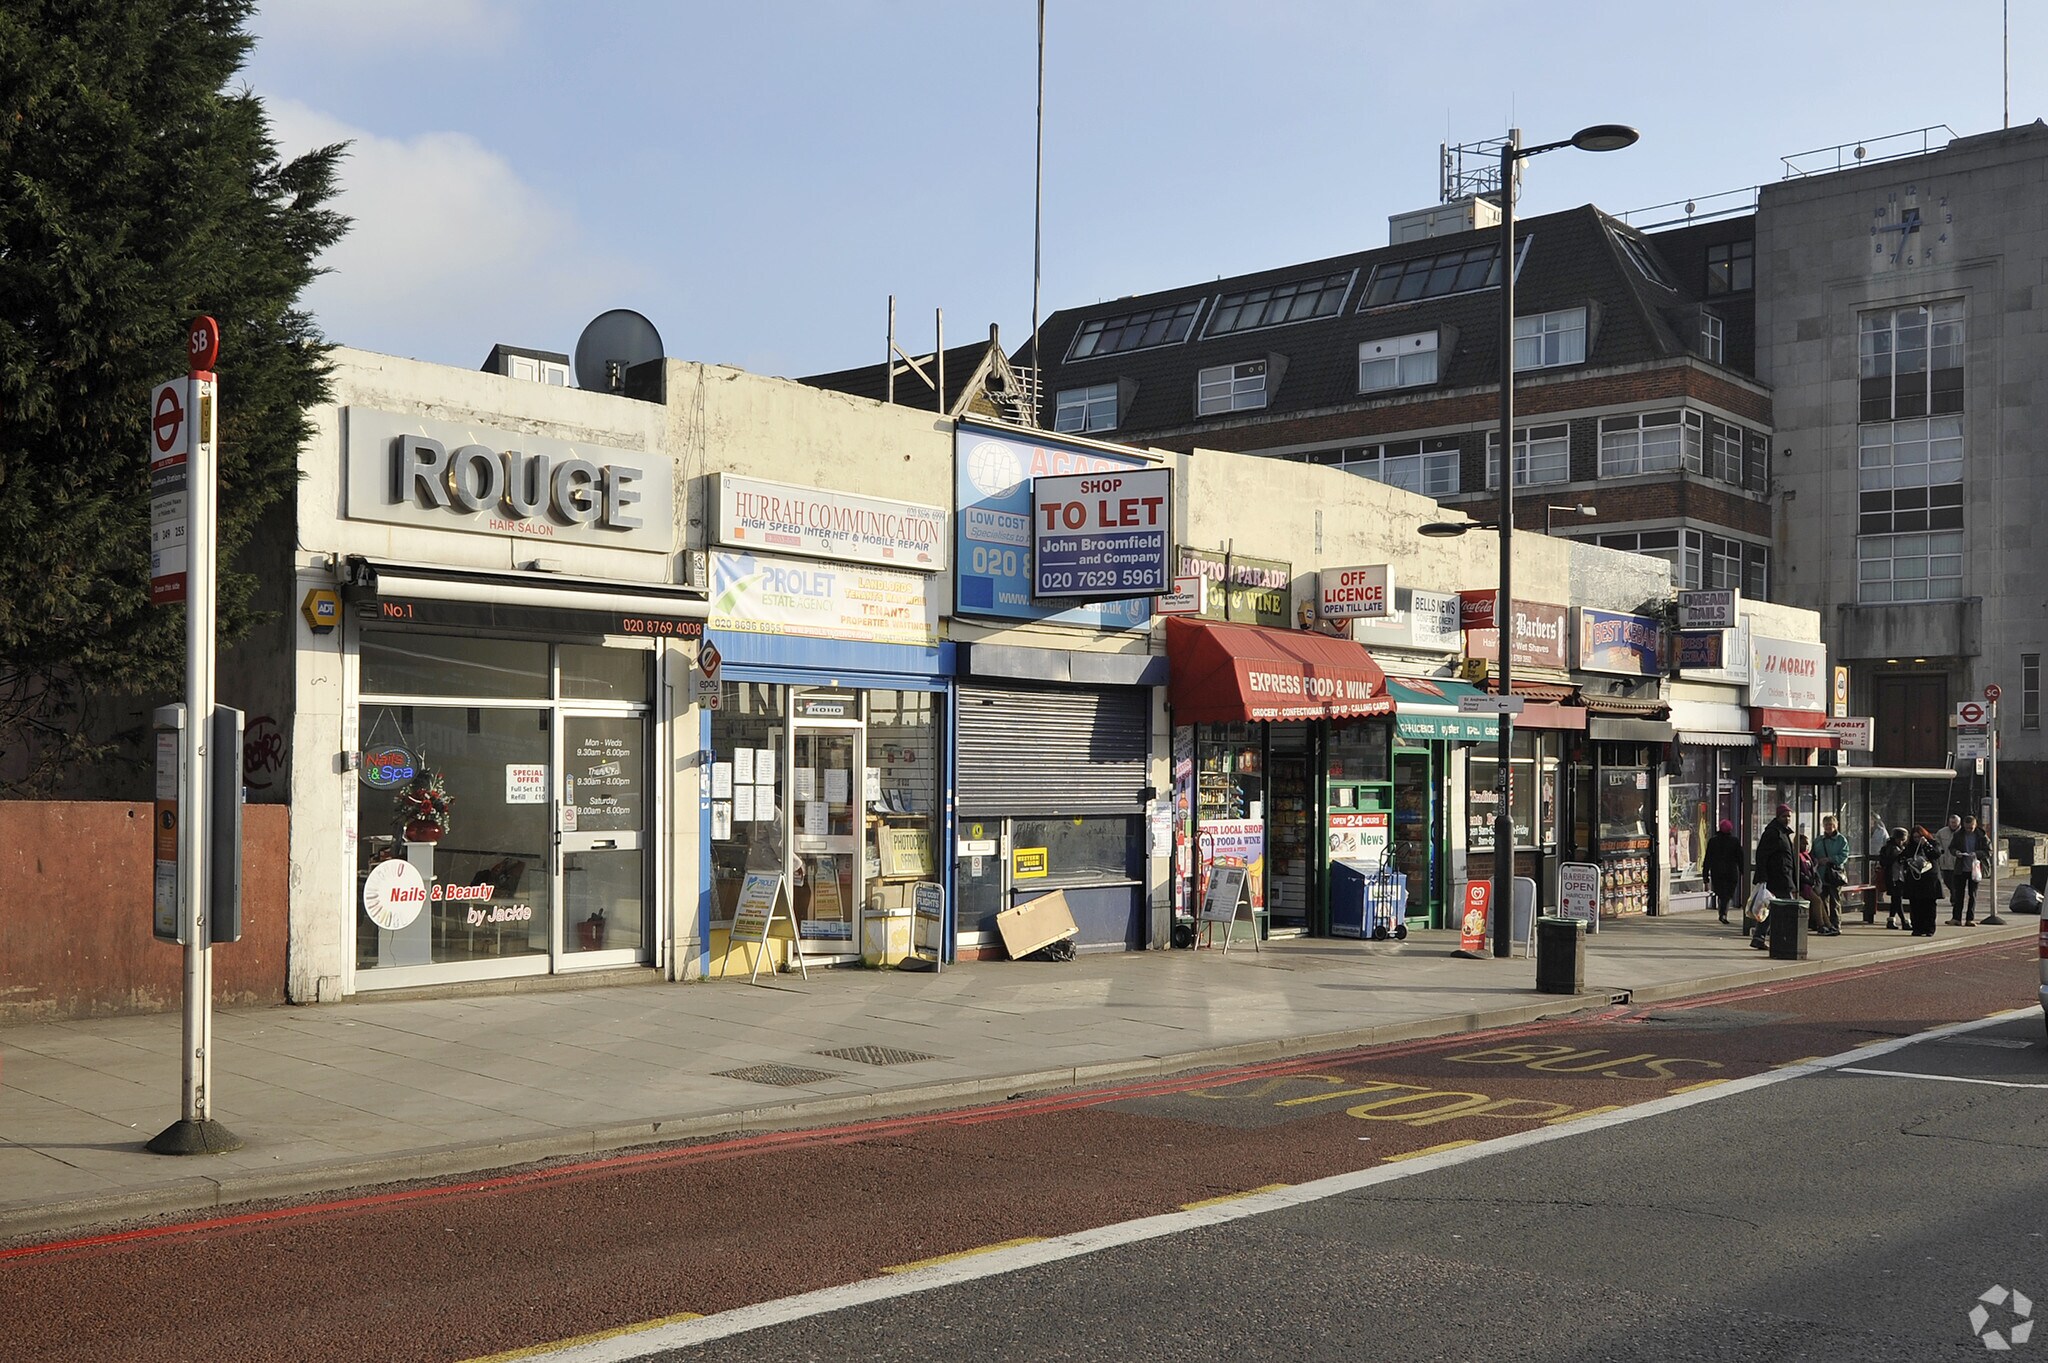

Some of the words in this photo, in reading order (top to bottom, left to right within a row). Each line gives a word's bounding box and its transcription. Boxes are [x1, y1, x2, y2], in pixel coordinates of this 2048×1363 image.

[1905, 185, 1917, 196] 12
[1888, 192, 1896, 203] 11
[1940, 197, 1947, 207] 2
[1875, 207, 1886, 218] 10
[1946, 214, 1952, 224] 3
[1870, 227, 1877, 236] 9
[1938, 233, 1948, 243] 4
[1875, 244, 1882, 253] 8
[1925, 248, 1932, 258] 5
[1890, 254, 1896, 264] 7
[1907, 256, 1913, 265] 6
[192, 330, 208, 353] SB
[391, 434, 643, 533] ROUGE
[1081, 479, 1122, 494] SHOP
[735, 491, 804, 526] HURRAH
[808, 502, 939, 544] COMMUNICATION
[970, 511, 994, 526] LOW
[998, 516, 1025, 530] COST
[1040, 501, 1087, 531] TO
[1098, 497, 1164, 528] LET
[175, 526, 184, 537] 255
[489, 519, 515, 532] HAIR
[518, 522, 553, 537] SALON
[741, 518, 766, 530] HIGH
[768, 522, 800, 535] SPEED
[803, 527, 850, 541] INTERNET
[852, 533, 859, 543] &
[862, 534, 894, 547] MOBILE
[897, 539, 929, 551] REPAIR
[970, 526, 1014, 542] Specialists
[1042, 538, 1077, 554] John
[1081, 535, 1161, 551] Broomfield
[973, 546, 1017, 577] 020
[1079, 553, 1101, 565] and
[1103, 551, 1161, 567] Company
[762, 566, 836, 598] PROLET
[1042, 572, 1072, 588] 020
[1077, 570, 1117, 587] 7629
[1122, 568, 1161, 586] 5961
[1237, 565, 1287, 590] PARADE
[1340, 571, 1367, 586] OFF
[858, 577, 913, 593] LANDLORDS
[1324, 586, 1383, 603] LICENCE
[1684, 593, 1730, 606] DREAM
[318, 601, 335, 614] ADT
[762, 594, 796, 608] ESTATE
[797, 598, 835, 613] AGENCY
[1232, 590, 1243, 609] &
[1246, 592, 1281, 613] WINE
[1324, 604, 1345, 614] OPEN
[1346, 603, 1363, 612] TILL
[1364, 602, 1383, 612] LATE
[1415, 597, 1436, 612] BELLS
[1437, 598, 1456, 615] NEWS
[383, 602, 414, 619] No.1
[862, 603, 910, 619] TENANTS
[1688, 606, 1726, 620] NAILS
[623, 617, 644, 632] 020
[647, 620, 672, 635] 8769
[676, 622, 701, 636] 4008
[715, 618, 732, 628] 020
[735, 620, 757, 630] 8696
[841, 615, 890, 628] PROPERTIES
[1593, 621, 1622, 645] BEST
[1623, 621, 1657, 651] KEBAB
[1483, 638, 1495, 648] Hair
[1516, 641, 1528, 651] Wet
[1529, 643, 1549, 653] Shaves
[1680, 637, 1708, 649] BEST
[1675, 650, 1717, 663] KEBAB
[1779, 656, 1816, 678] MORLYS
[700, 680, 718, 692] epay
[1248, 672, 1300, 695] EXPRESS
[1303, 677, 1334, 697] FOOD
[1336, 680, 1344, 698] &
[1346, 680, 1373, 699] WINE
[1986, 689, 1998, 697] SC
[1252, 708, 1279, 717] GROCERY
[1329, 705, 1340, 715] TOP
[1341, 704, 1348, 714] UP
[1351, 703, 1372, 712] CALLING
[1372, 701, 1390, 711] CARDS
[1441, 724, 1460, 737] oyster
[1834, 721, 1866, 729] MORLYS
[584, 738, 599, 747] Mon
[604, 738, 623, 747] Weds
[365, 751, 404, 768] Nails
[576, 748, 601, 757] 9.30am
[606, 748, 630, 758] 6.00pm
[371, 767, 380, 780] &
[380, 765, 414, 783] Spa
[512, 769, 544, 777] SPECIAL
[576, 777, 601, 786] 9.30am
[589, 796, 617, 807] Saturday
[1470, 790, 1499, 804] Tradition
[577, 806, 601, 816] 9.00am
[606, 806, 630, 816] 6.00pm
[1332, 816, 1346, 825] OPEN
[1346, 815, 1363, 827] 24
[1220, 825, 1242, 835] LOCAL
[1243, 825, 1264, 834] SHOP
[893, 834, 929, 851] PHOTOCOPY
[1216, 837, 1235, 846] FOOD
[1243, 836, 1261, 845] WINE
[1360, 832, 1384, 845] News
[1563, 872, 1595, 882] BARBERS
[390, 887, 426, 902] Nails
[431, 885, 442, 901] &
[446, 882, 495, 902] Beauty
[1564, 882, 1594, 891] OPEN
[916, 889, 927, 897] LOW
[928, 890, 940, 900] COST
[917, 896, 940, 908] FLIGHTS
[467, 907, 486, 927] by
[488, 903, 532, 923] Jackie
[1443, 1044, 1724, 1082] BUS
[1185, 1074, 1574, 1127] STOP
